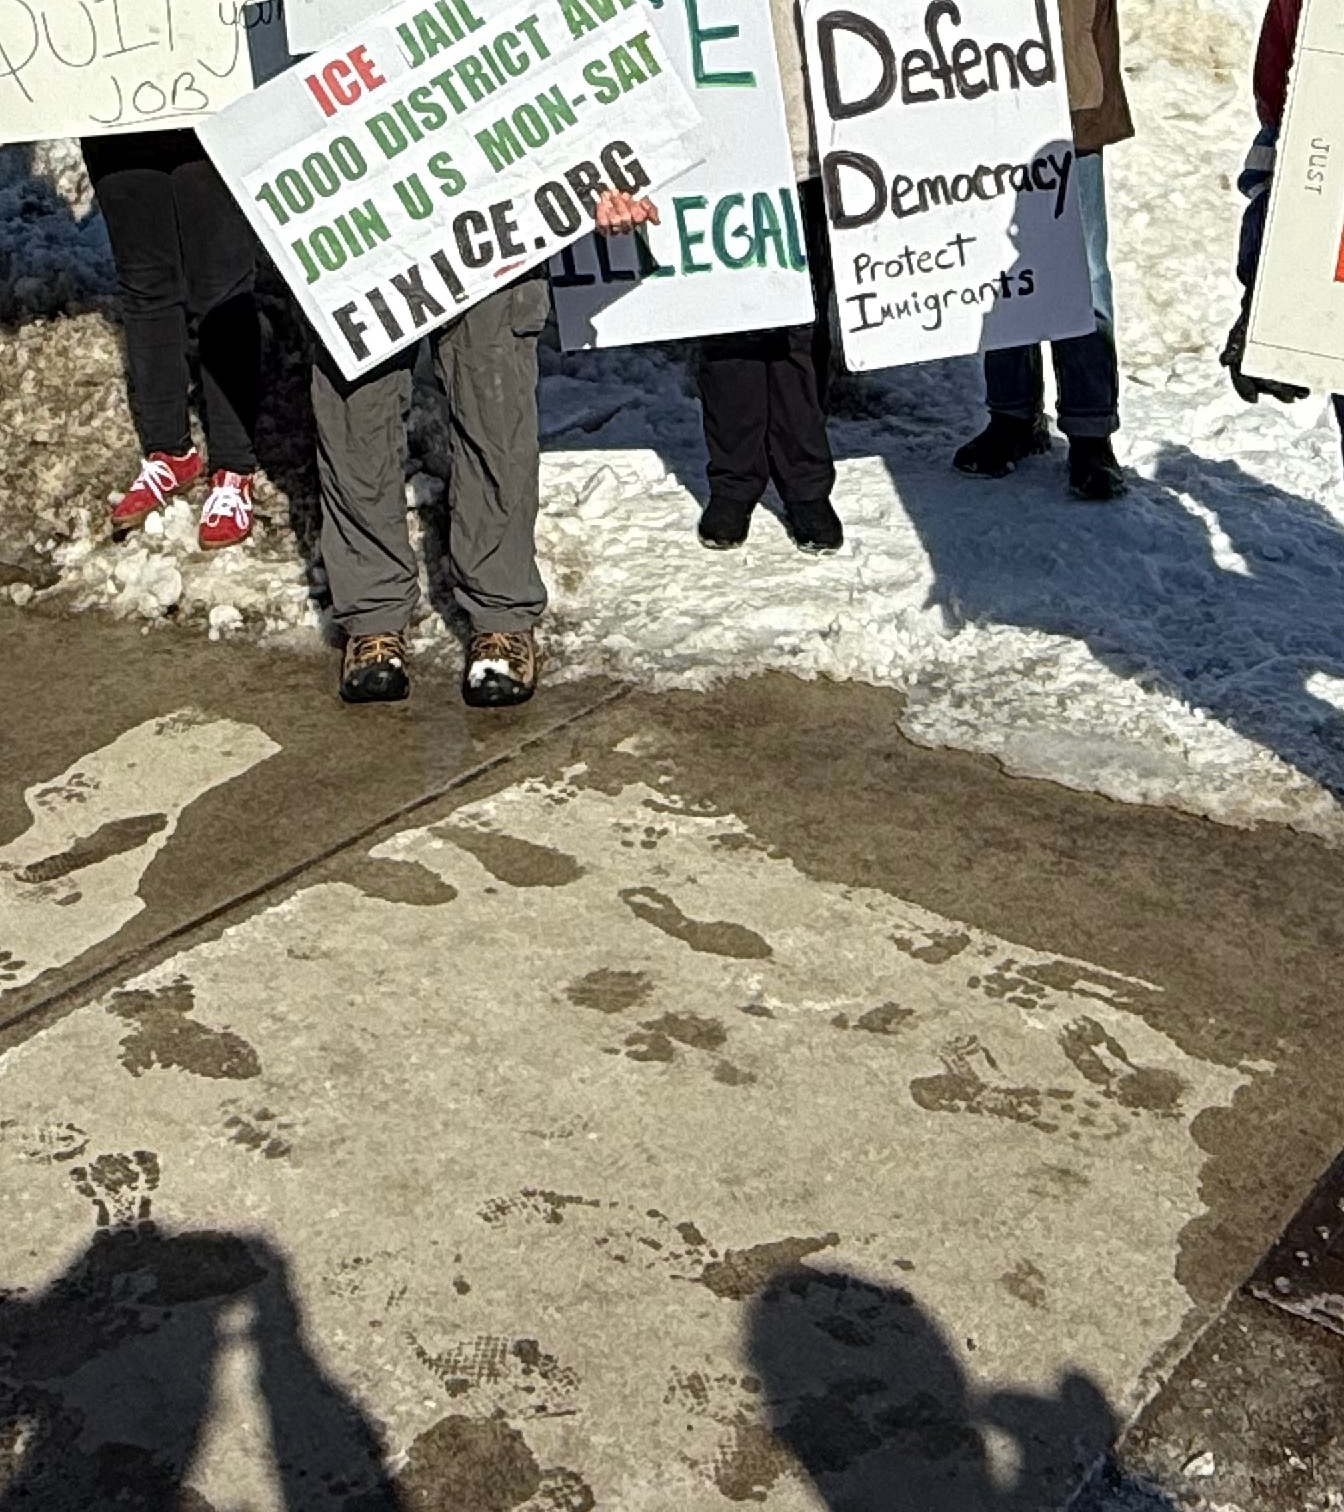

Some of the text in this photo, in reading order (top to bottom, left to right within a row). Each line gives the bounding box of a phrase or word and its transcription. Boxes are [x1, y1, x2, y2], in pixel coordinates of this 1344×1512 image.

[89, 72, 209, 123] JOB
[304, 44, 386, 117] ICE
[255, 135, 368, 226] 1000
[364, 14, 552, 160] DISTRICT
[290, 198, 392, 285] JOIN
[474, 30, 663, 174] MON-SAT
[823, 151, 1072, 229] Democracy
[1305, 137, 1330, 195] JUST
[853, 233, 977, 285] Protect
